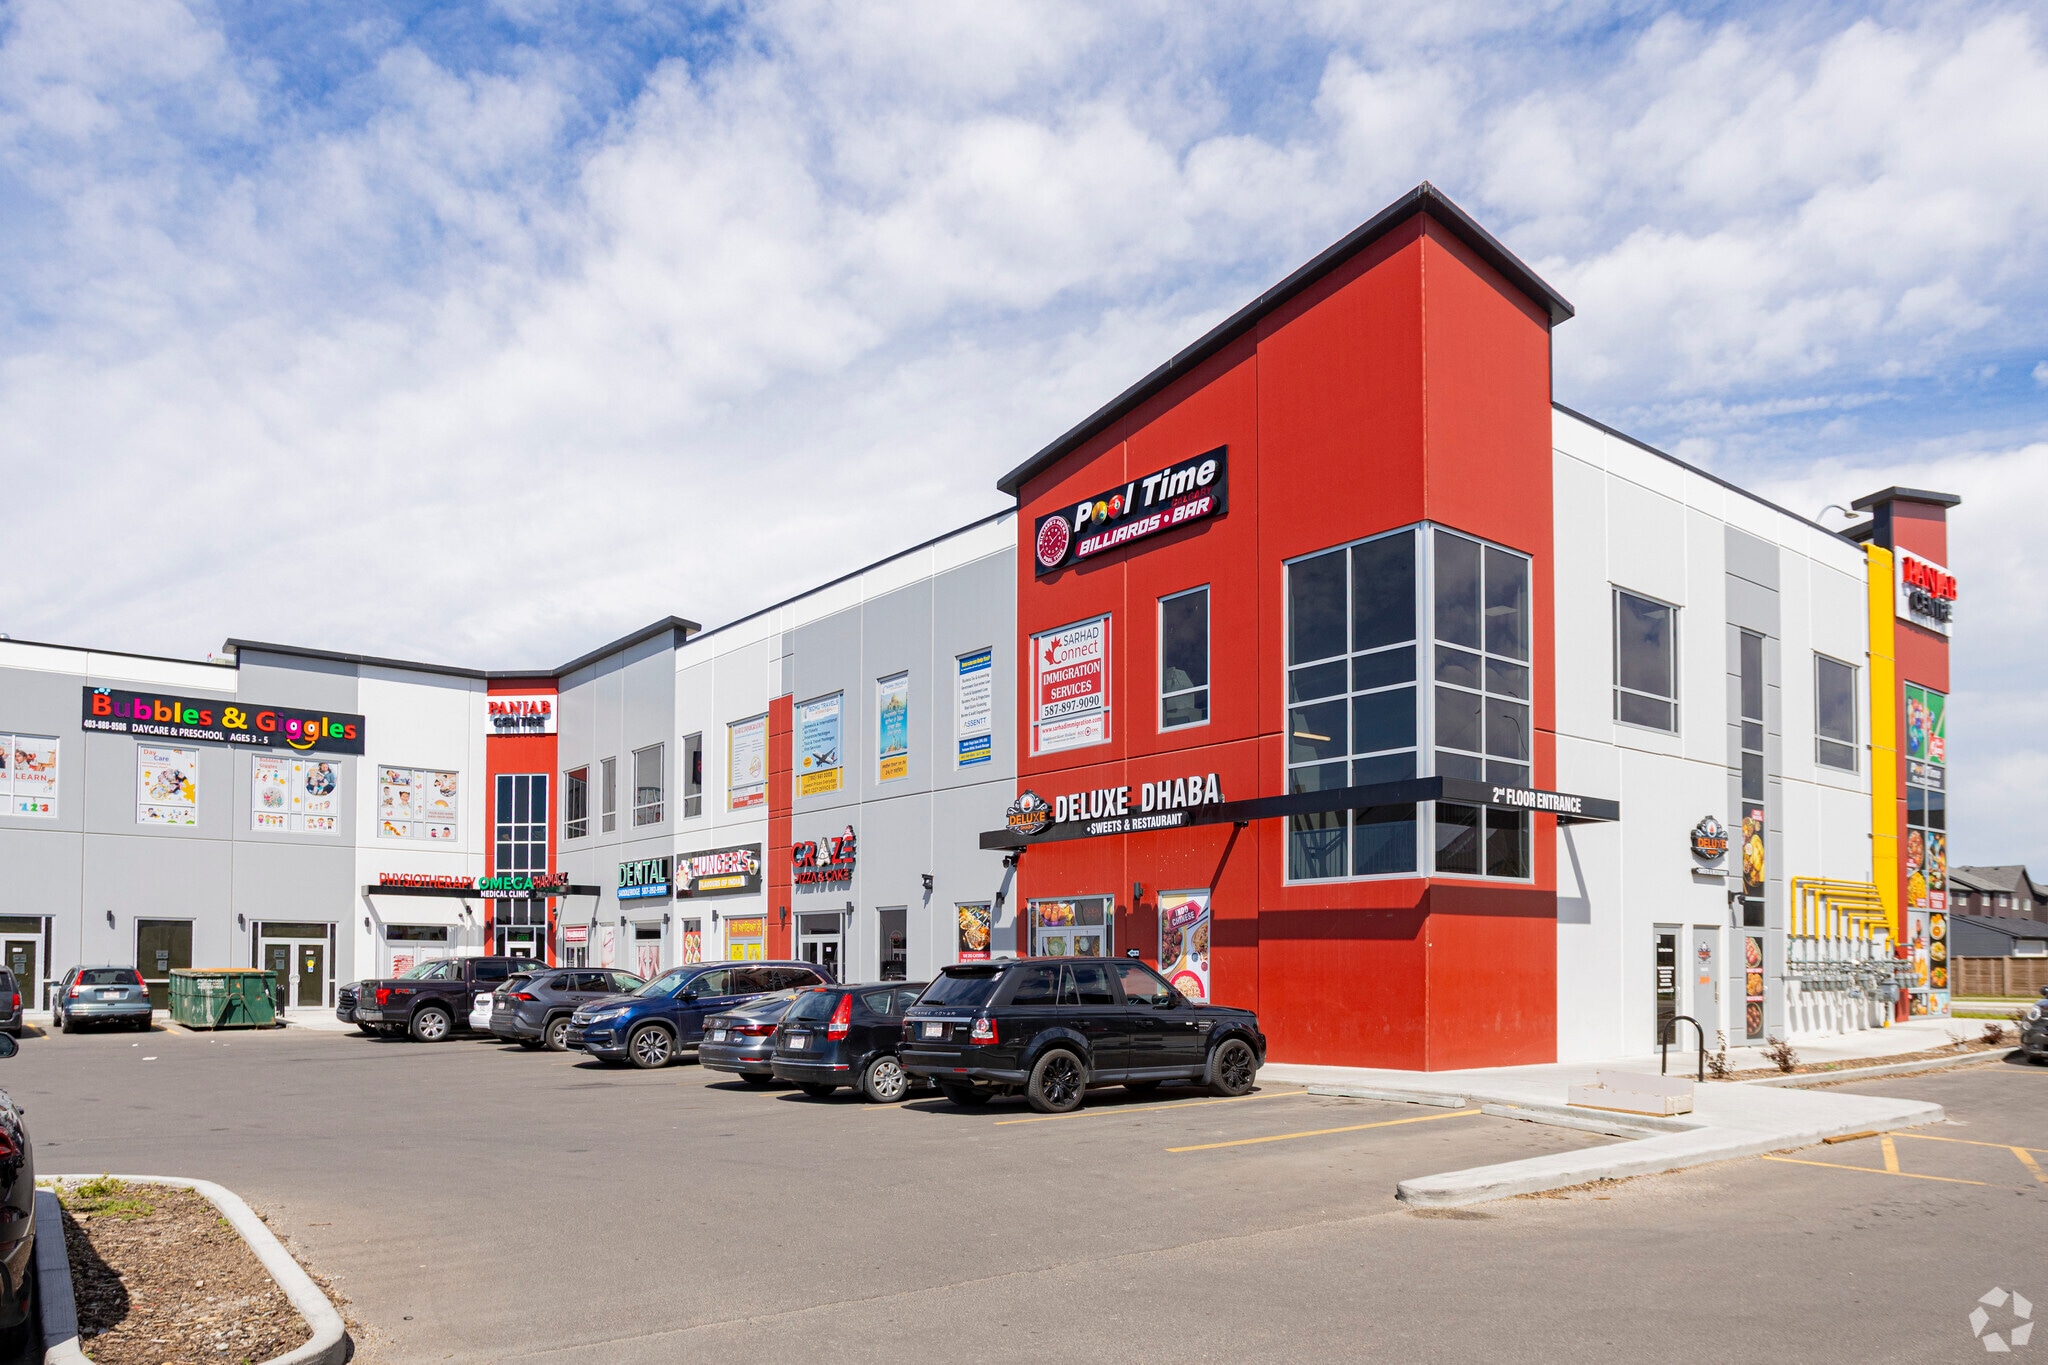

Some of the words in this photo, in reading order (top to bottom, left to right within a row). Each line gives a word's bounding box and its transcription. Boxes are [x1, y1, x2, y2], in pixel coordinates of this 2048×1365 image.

[1142, 460, 1216, 507] Time
[1079, 513, 1161, 556] BILLIARDS
[1172, 496, 1210, 523] BAR
[1064, 626, 1099, 647] SARHAD
[1053, 641, 1098, 665] Connect
[1043, 660, 1101, 686] IMMIGRATION
[1050, 680, 1092, 700] SERVICES
[487, 700, 551, 717] PANJAB
[1044, 694, 1100, 717] 587-897-9090
[92, 693, 213, 726] Bubbles
[222, 707, 248, 729] &
[255, 711, 357, 742] Giggles
[493, 716, 545, 728] CENTRE
[963, 716, 987, 728] ASSENTT
[132, 724, 169, 735] DAYCARE
[170, 727, 178, 736] &
[179, 728, 224, 740] PRESCHOOL
[230, 733, 250, 742] AGES
[251, 735, 256, 743] 3
[15, 773, 47, 781] LEARN
[1055, 786, 1128, 823] DELUXE
[1141, 773, 1219, 812] DHABA
[1492, 787, 1505, 803] 2nd
[1506, 788, 1536, 808] FLOOR
[1537, 792, 1582, 813] ENTRANCE
[1009, 811, 1046, 826] DELUXE
[1091, 819, 1122, 834] SWEETS
[1124, 819, 1131, 831] &
[1132, 813, 1182, 830] RESTAURANT
[791, 836, 853, 868] CRAZE
[1697, 837, 1727, 848] DELUXE
[619, 859, 665, 887] DENTAL
[692, 851, 749, 876] HUNGER'S
[380, 872, 476, 889] PHYSIOTHERAPY
[478, 876, 533, 890] OMEGA
[795, 872, 816, 884] PIZZA
[818, 871, 824, 882] &
[826, 868, 849, 882] CAKE
[480, 890, 507, 898] MEDICAL
[508, 890, 529, 898] CLINIC
[1171, 912, 1195, 926] CHINESE
[1175, 905, 1189, 917] INDO
